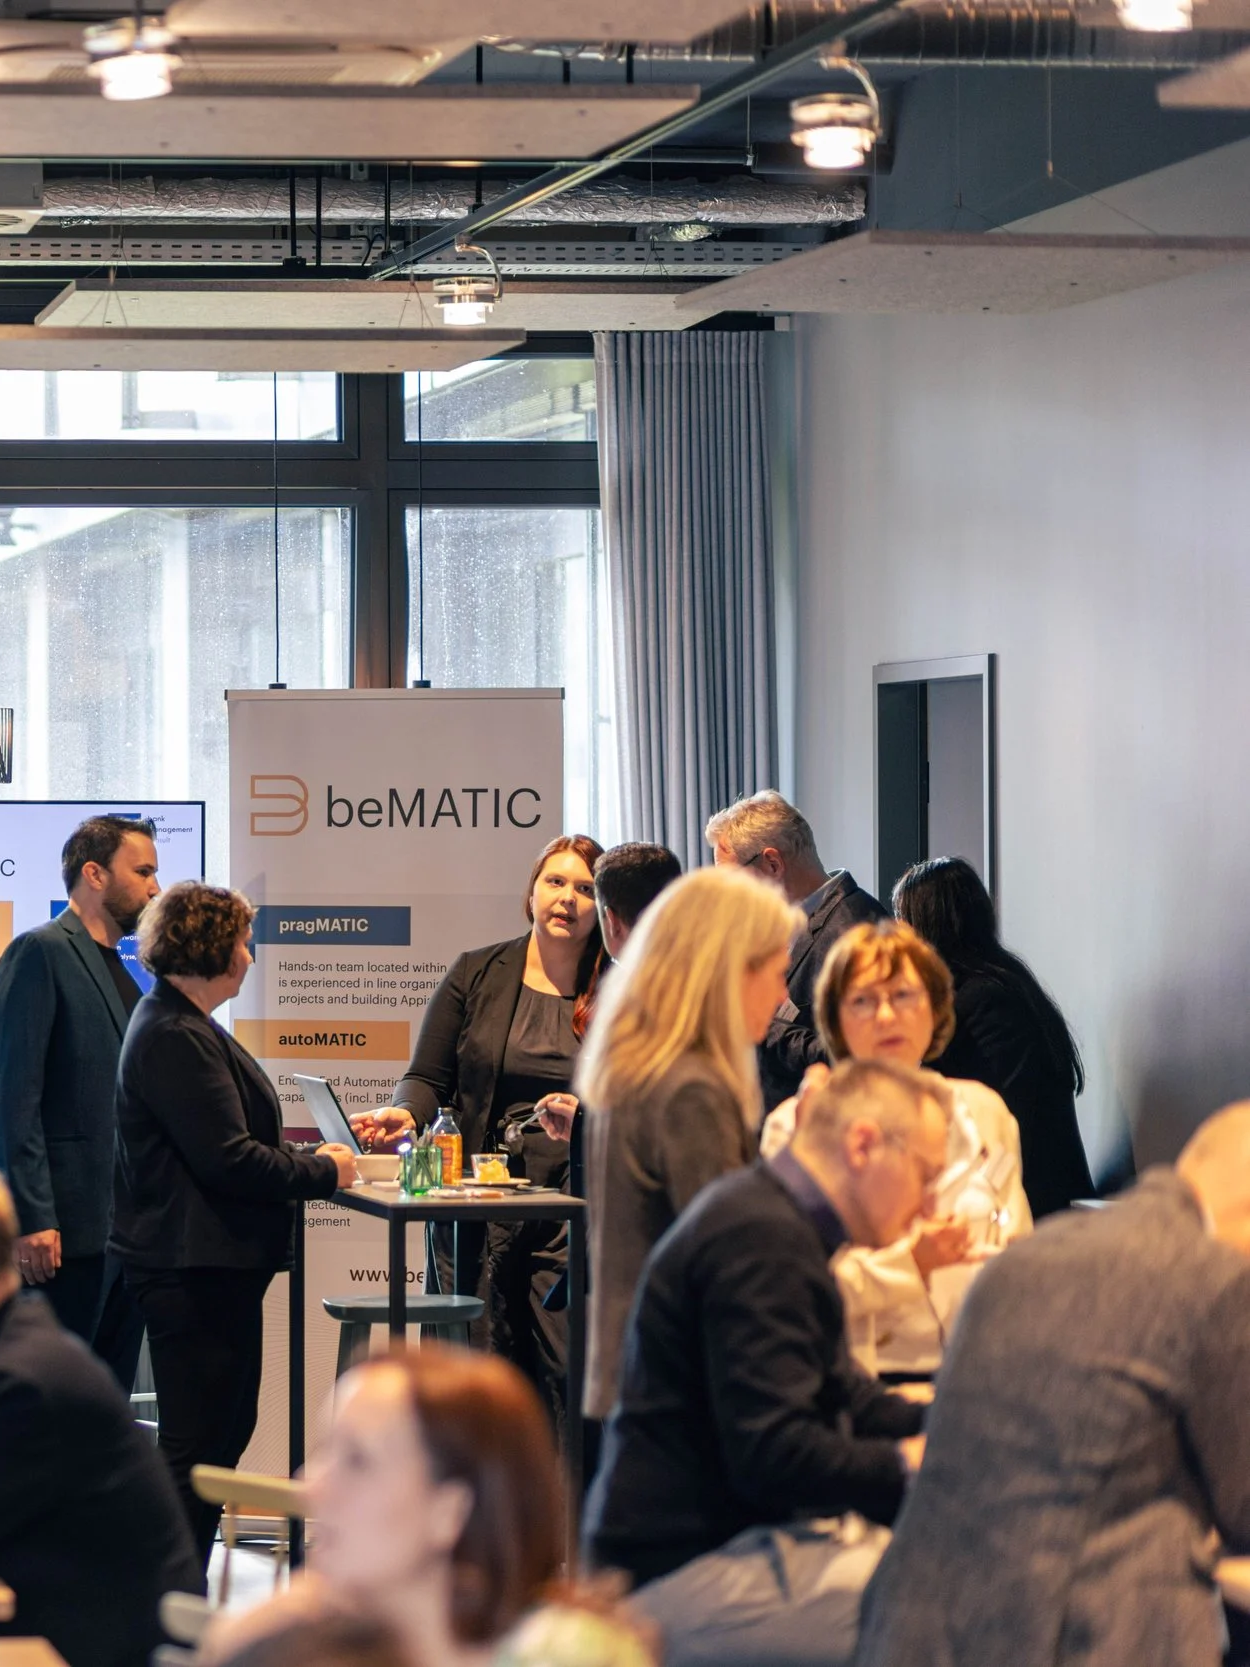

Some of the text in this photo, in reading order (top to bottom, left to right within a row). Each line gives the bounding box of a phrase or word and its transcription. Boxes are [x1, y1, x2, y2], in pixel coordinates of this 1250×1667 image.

[327, 785, 542, 829] beMATIC
[279, 918, 369, 935] pragMATIC
[278, 961, 447, 973] Hands-on team located within
[278, 977, 288, 988] is
[290, 977, 360, 990] experienced
[363, 977, 374, 989] in
[376, 977, 397, 989] line
[278, 993, 430, 1008] projects and building Appi
[278, 1033, 367, 1047] autoMATIC
[345, 1091, 372, 1105] (incl.
